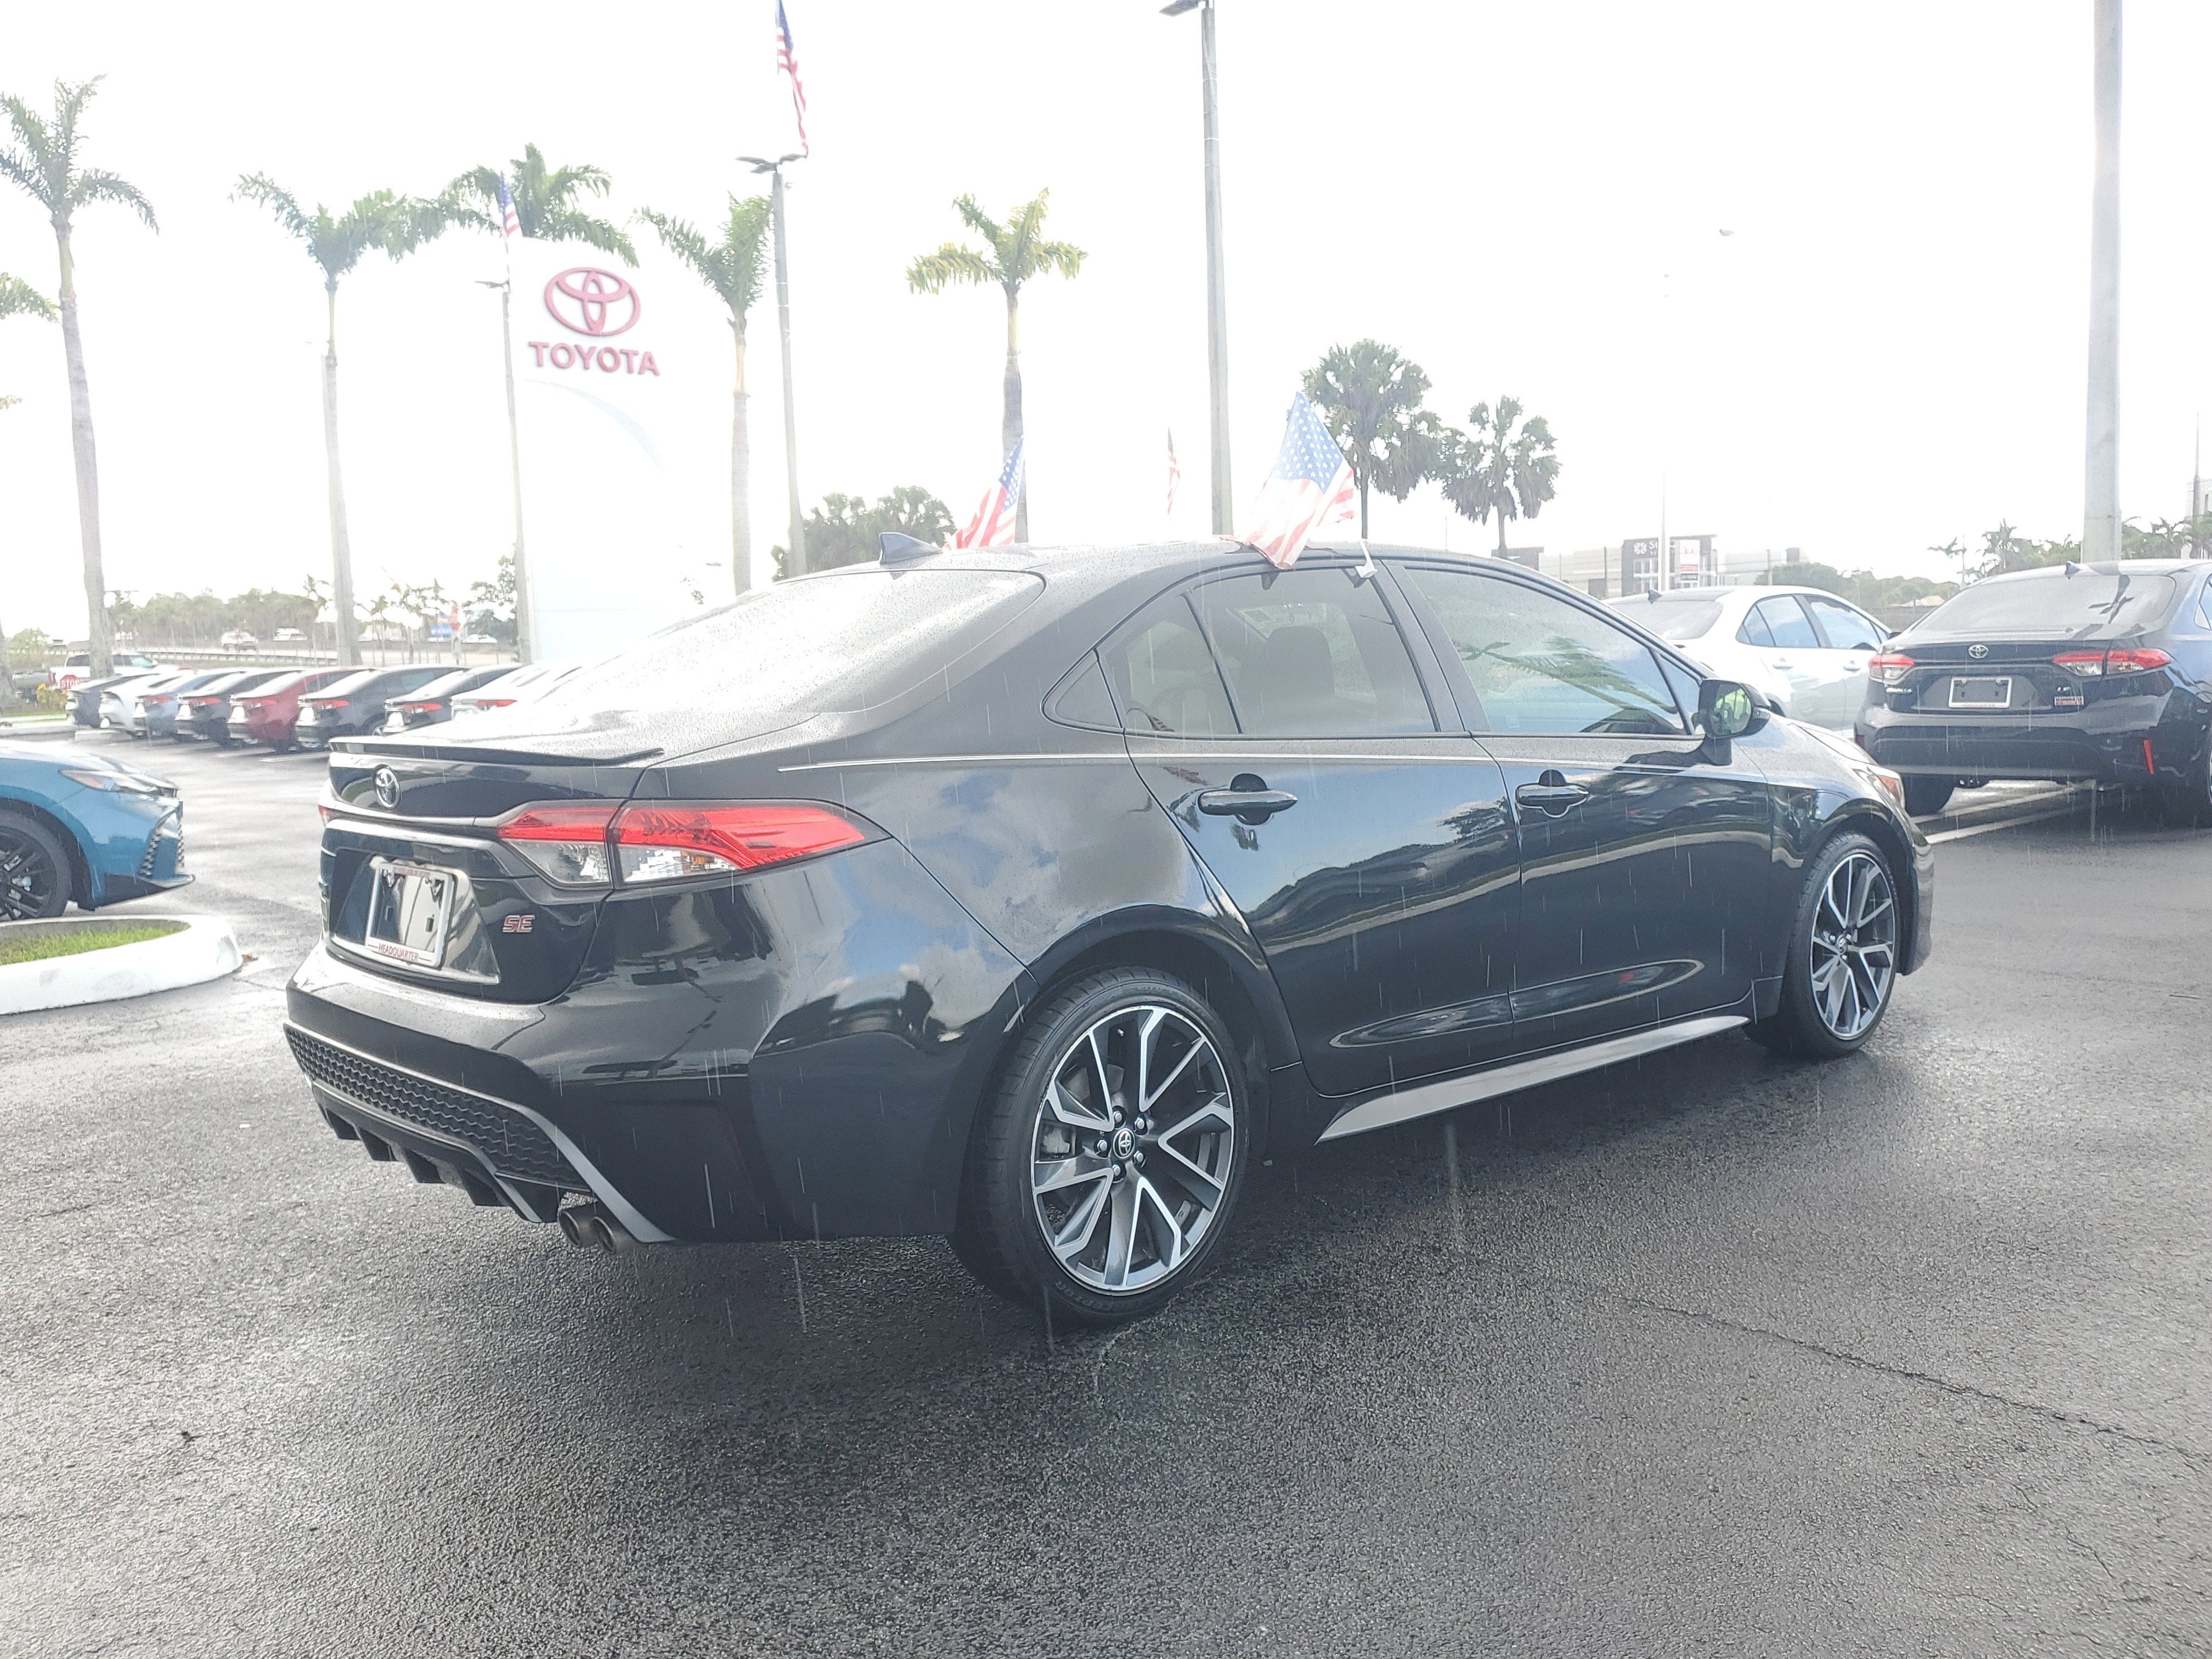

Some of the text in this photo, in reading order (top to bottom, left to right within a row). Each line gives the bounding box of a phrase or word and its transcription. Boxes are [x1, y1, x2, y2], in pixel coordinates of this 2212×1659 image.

[528, 341, 661, 377] TOYOTA
[61, 678, 81, 688] STOP
[502, 915, 535, 933] SE
[379, 943, 419, 961] HEADQUARTER
